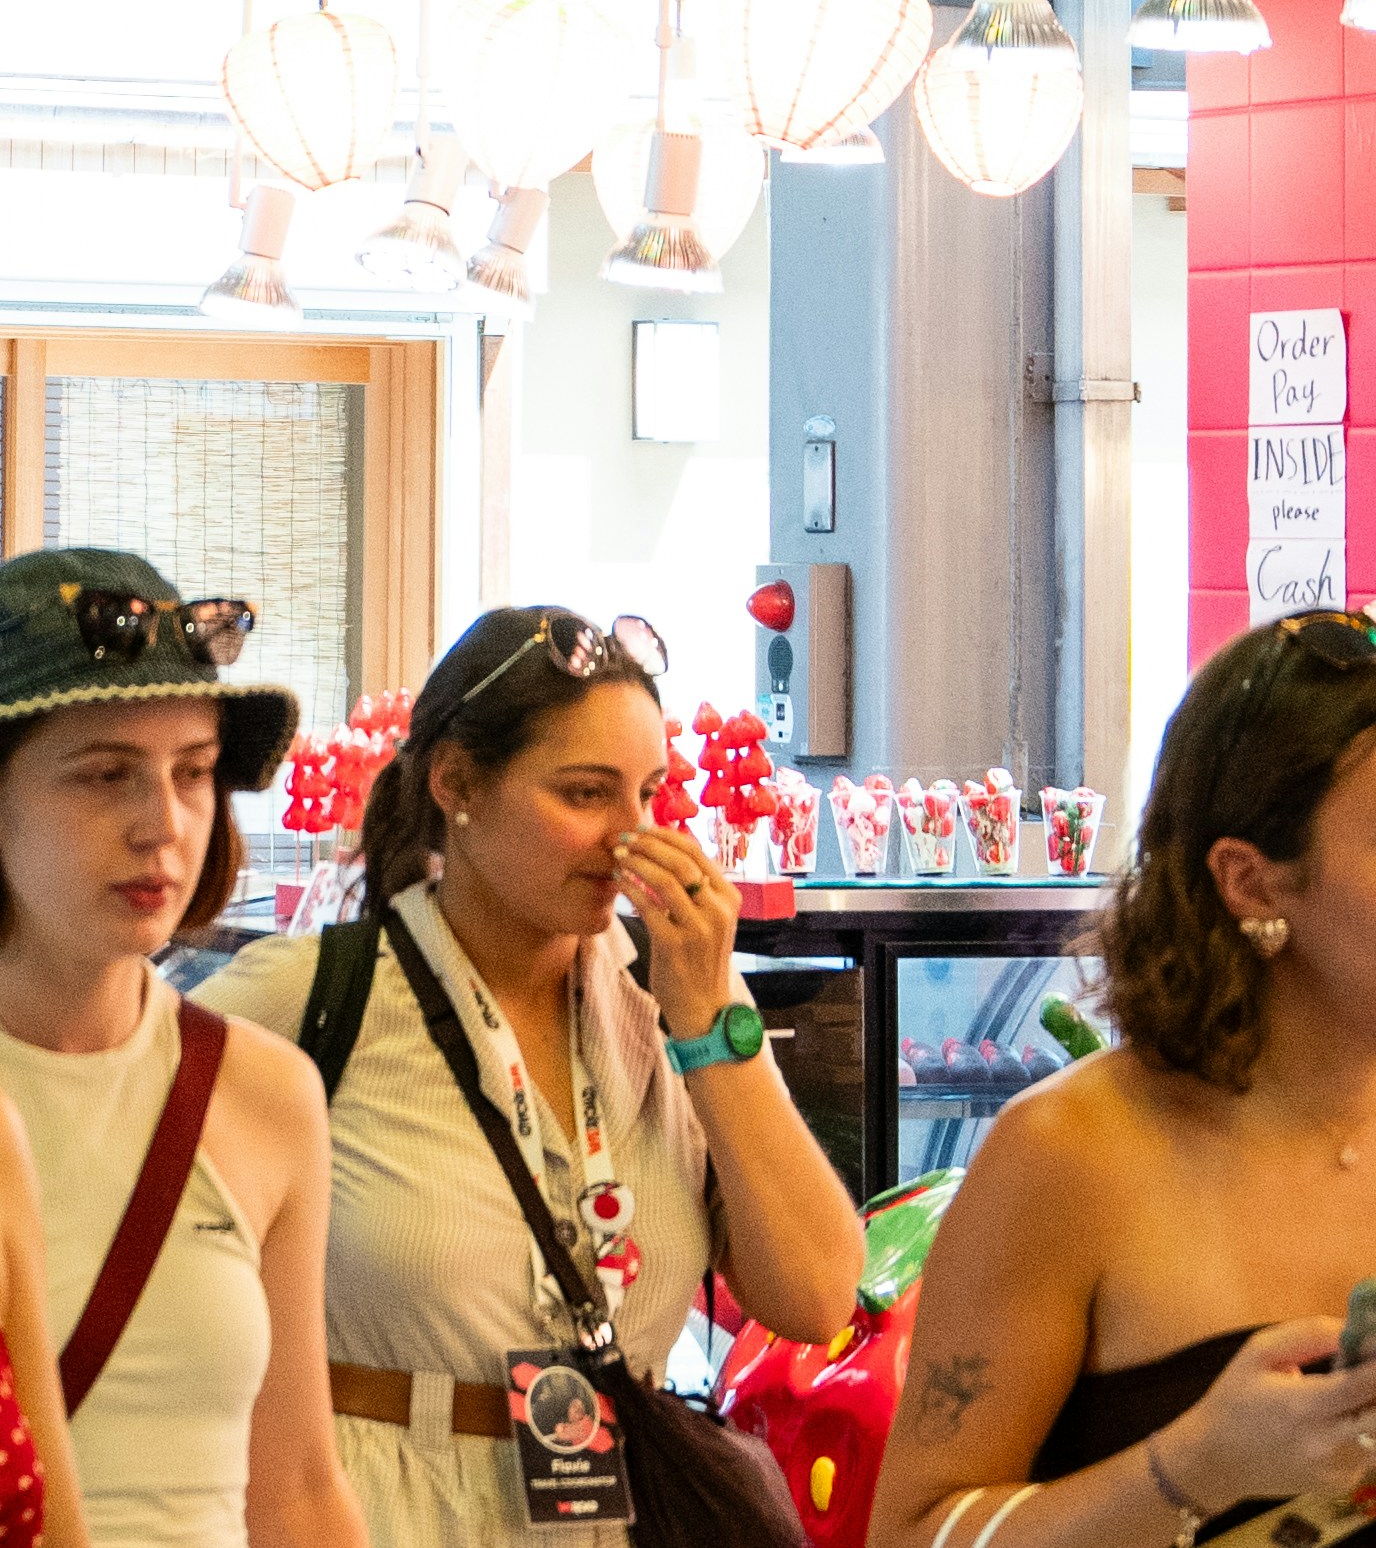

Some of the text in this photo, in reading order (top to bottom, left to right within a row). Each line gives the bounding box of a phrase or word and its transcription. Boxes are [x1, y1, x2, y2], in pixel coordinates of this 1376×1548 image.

[1257, 319, 1335, 362] Order
[1273, 368, 1321, 414] Pay
[1253, 431, 1344, 486] INSIDE
[1272, 499, 1320, 531] please
[1257, 543, 1337, 608] Cash
